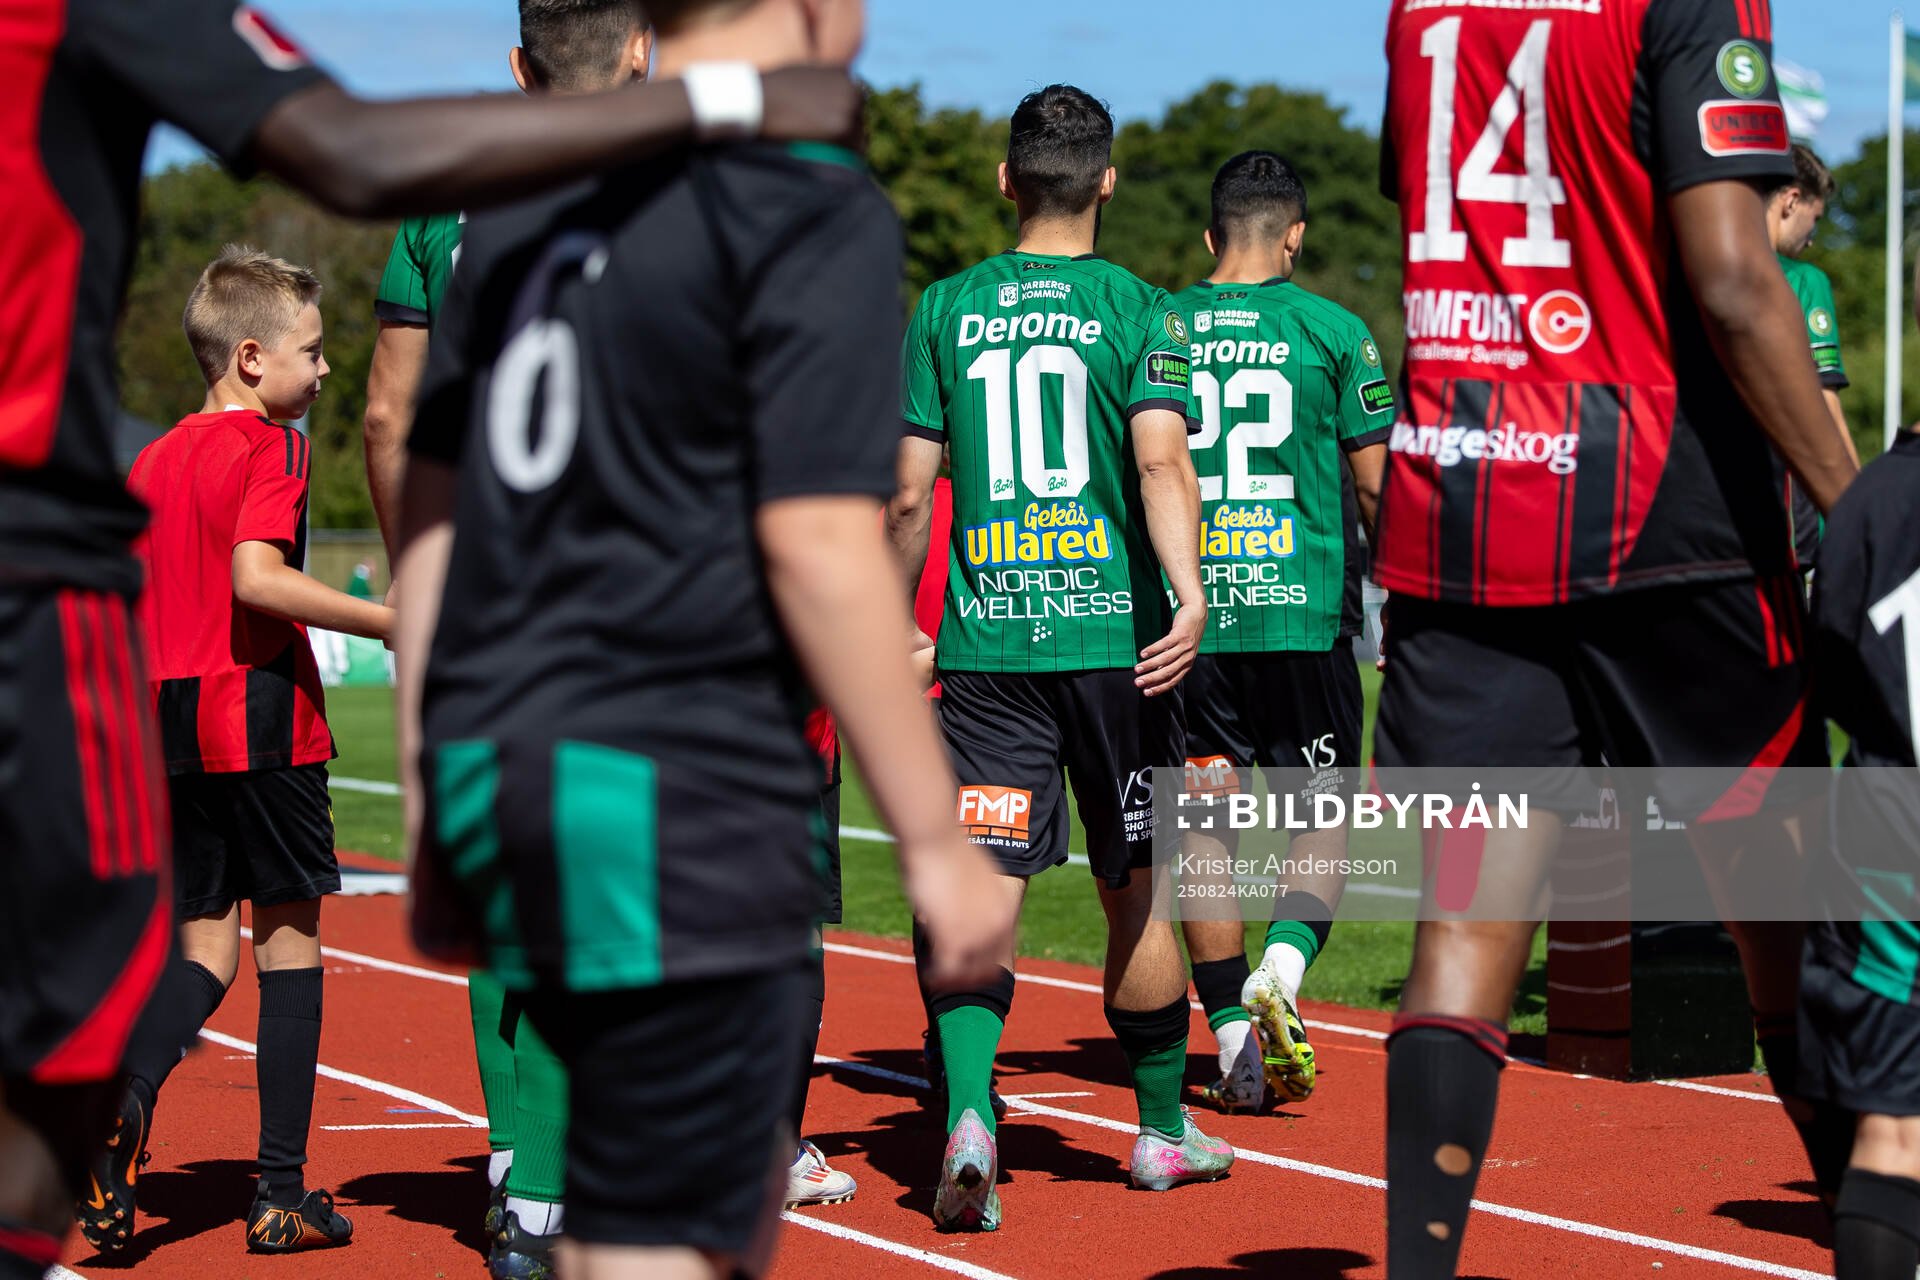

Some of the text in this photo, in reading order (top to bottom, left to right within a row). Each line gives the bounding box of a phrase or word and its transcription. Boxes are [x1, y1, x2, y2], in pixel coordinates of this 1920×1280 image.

[1408, 15, 1571, 268] 14
[1021, 280, 1071, 293] VARBERGS
[1022, 289, 1067, 301] KOMMUN
[1213, 310, 1260, 320] VARBERGS
[1214, 318, 1256, 328] KOMMUN
[958, 311, 1101, 347] Derome
[1190, 338, 1290, 365] erome
[1470, 344, 1529, 370] Sverige
[1152, 359, 1188, 376] UNIB
[1364, 384, 1391, 402] UNIB
[966, 344, 1090, 501] 10
[1188, 368, 1294, 501] 22
[993, 479, 1013, 494] Bois
[1047, 476, 1067, 491] Bois
[1024, 501, 1089, 531] Gekås
[1213, 504, 1276, 530] Gekås
[967, 518, 1111, 565] Ullared
[1199, 518, 1294, 557] lared
[979, 567, 1099, 594] NORDIC
[1200, 562, 1280, 585] ORDIC
[959, 591, 1133, 619] WELLNESS
[1167, 584, 1308, 609] LNESS
[1301, 733, 1337, 774] VS
[1116, 765, 1155, 810] VS
[960, 789, 1028, 824] FMP
[1123, 806, 1155, 822] BERGS
[1125, 814, 1161, 833] SHOTELL
[986, 838, 1004, 846] MUR
[1011, 841, 1030, 849] PUTS
